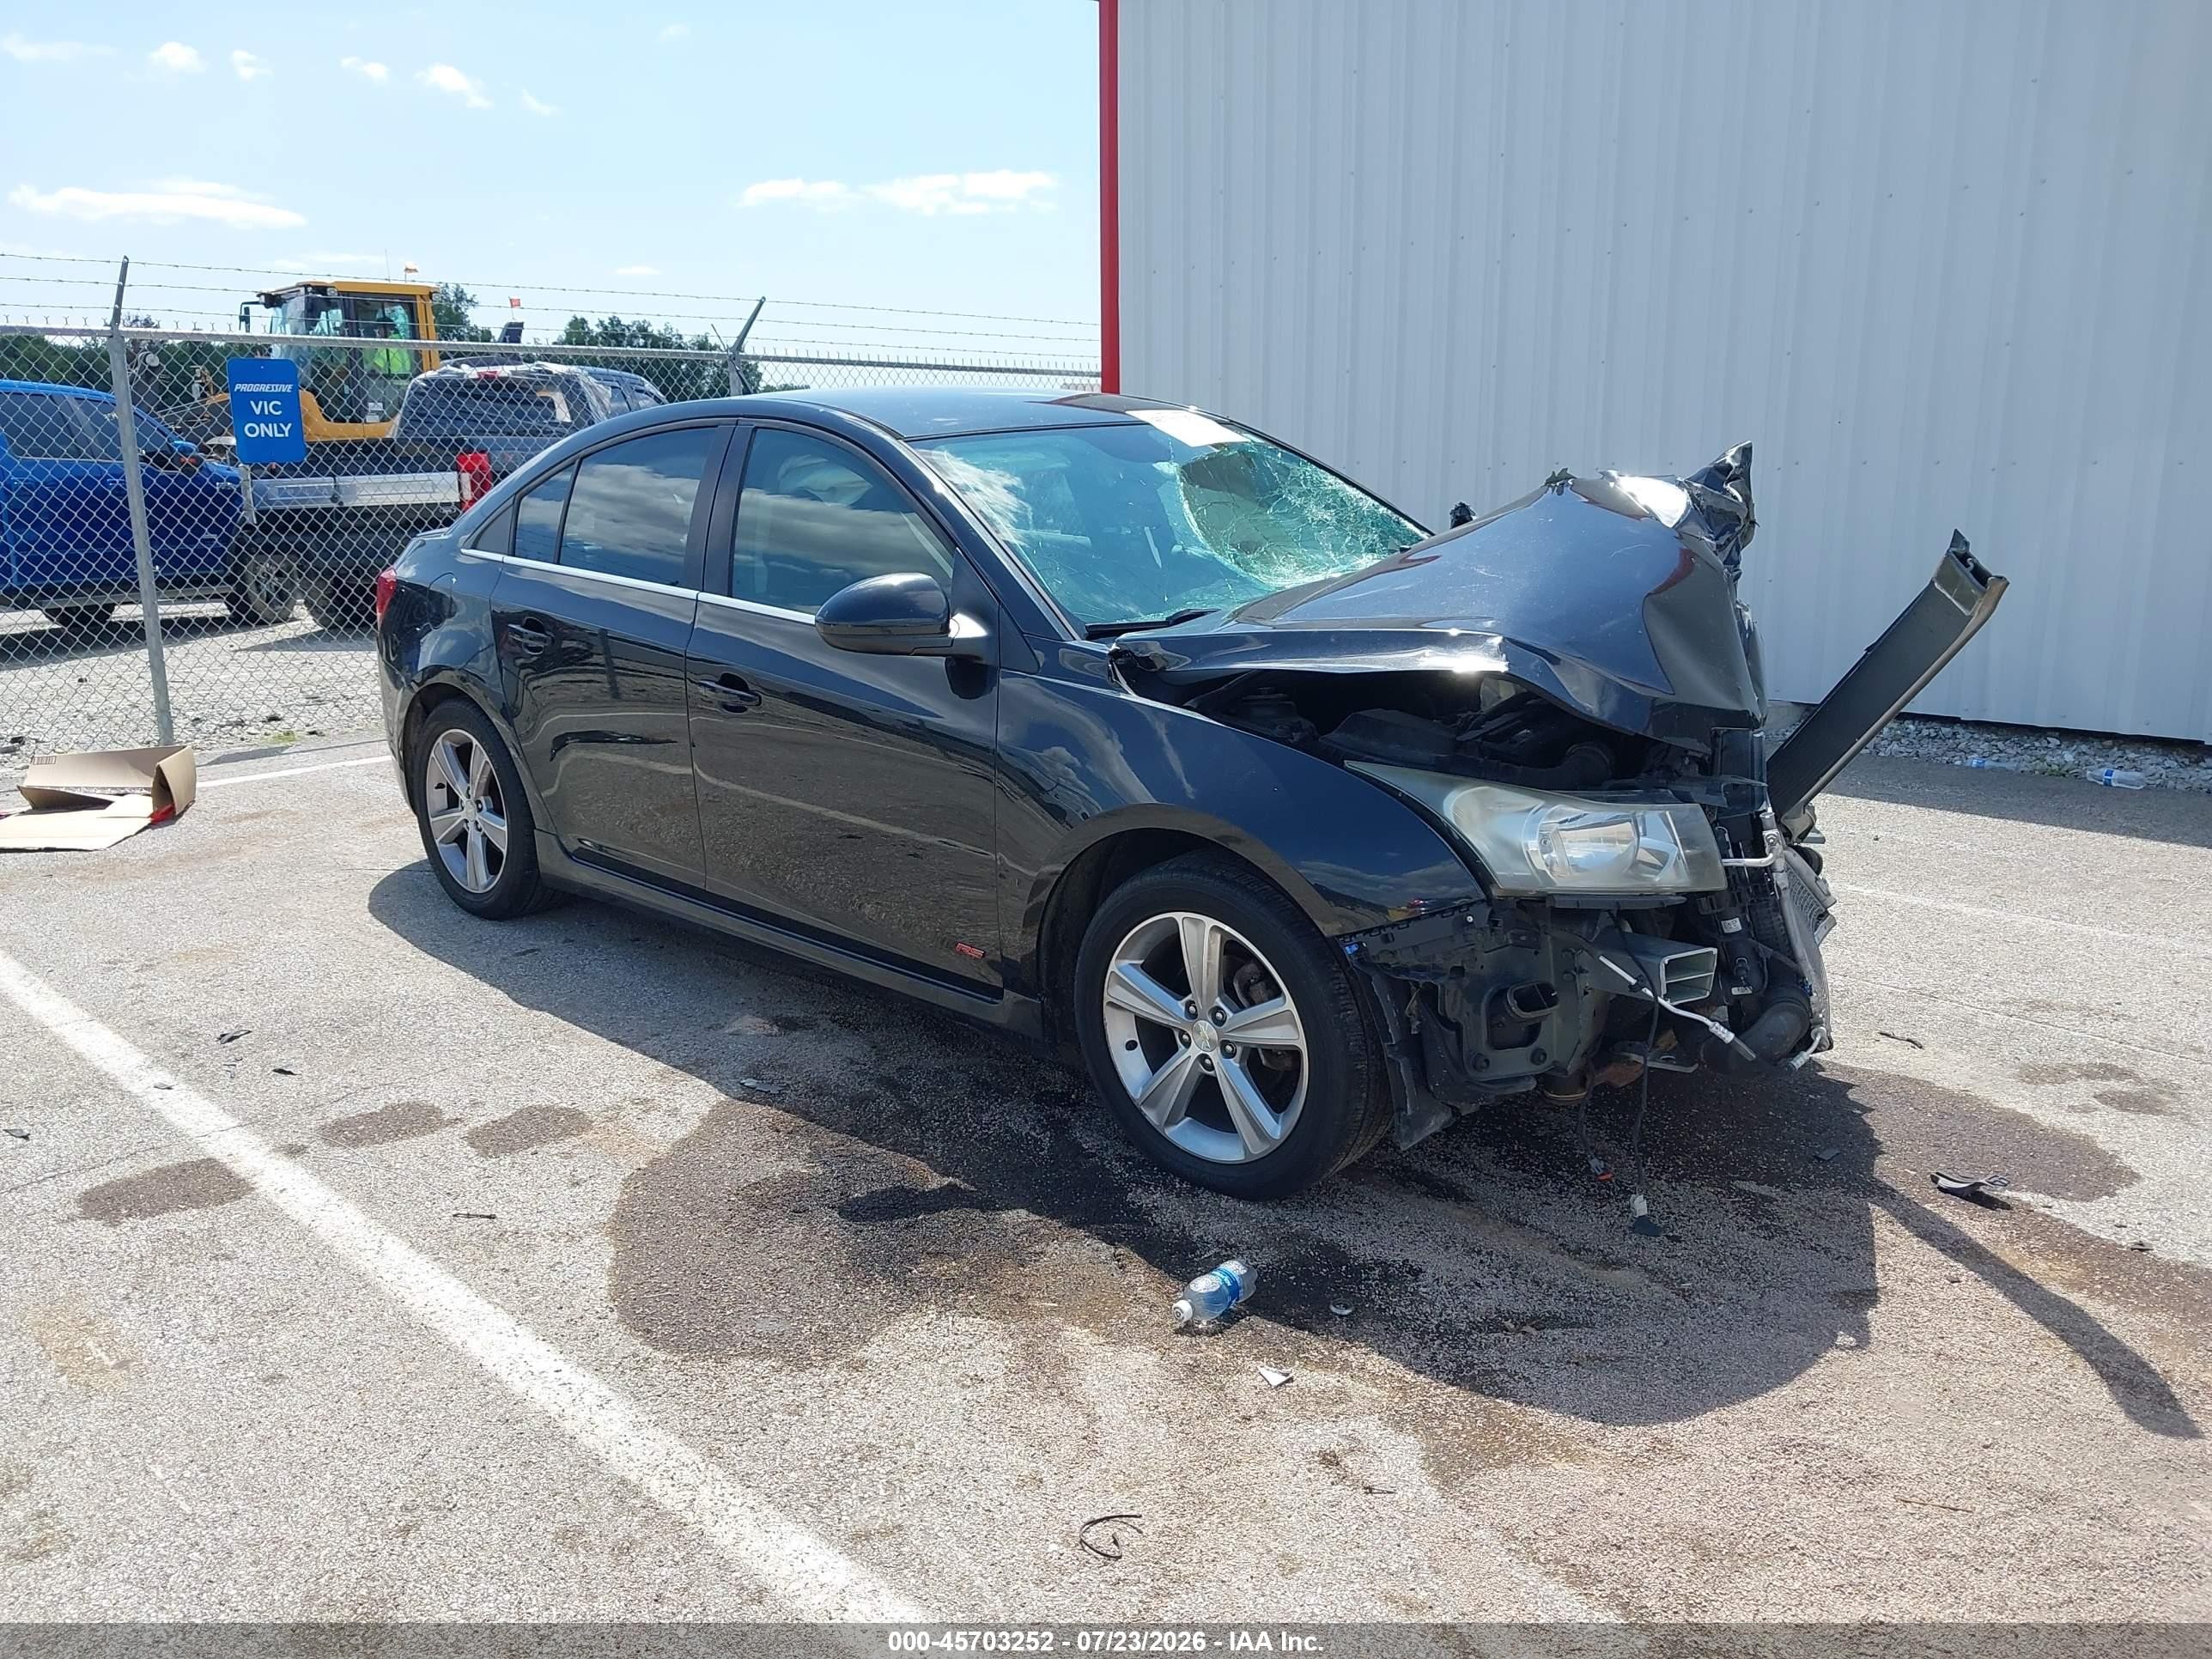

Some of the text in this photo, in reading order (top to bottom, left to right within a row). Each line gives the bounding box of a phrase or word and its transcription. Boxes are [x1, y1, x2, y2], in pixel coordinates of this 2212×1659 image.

[234, 384, 294, 392] PROGRESSIVE
[250, 400, 282, 415] VIC
[244, 422, 291, 437] ONLY
